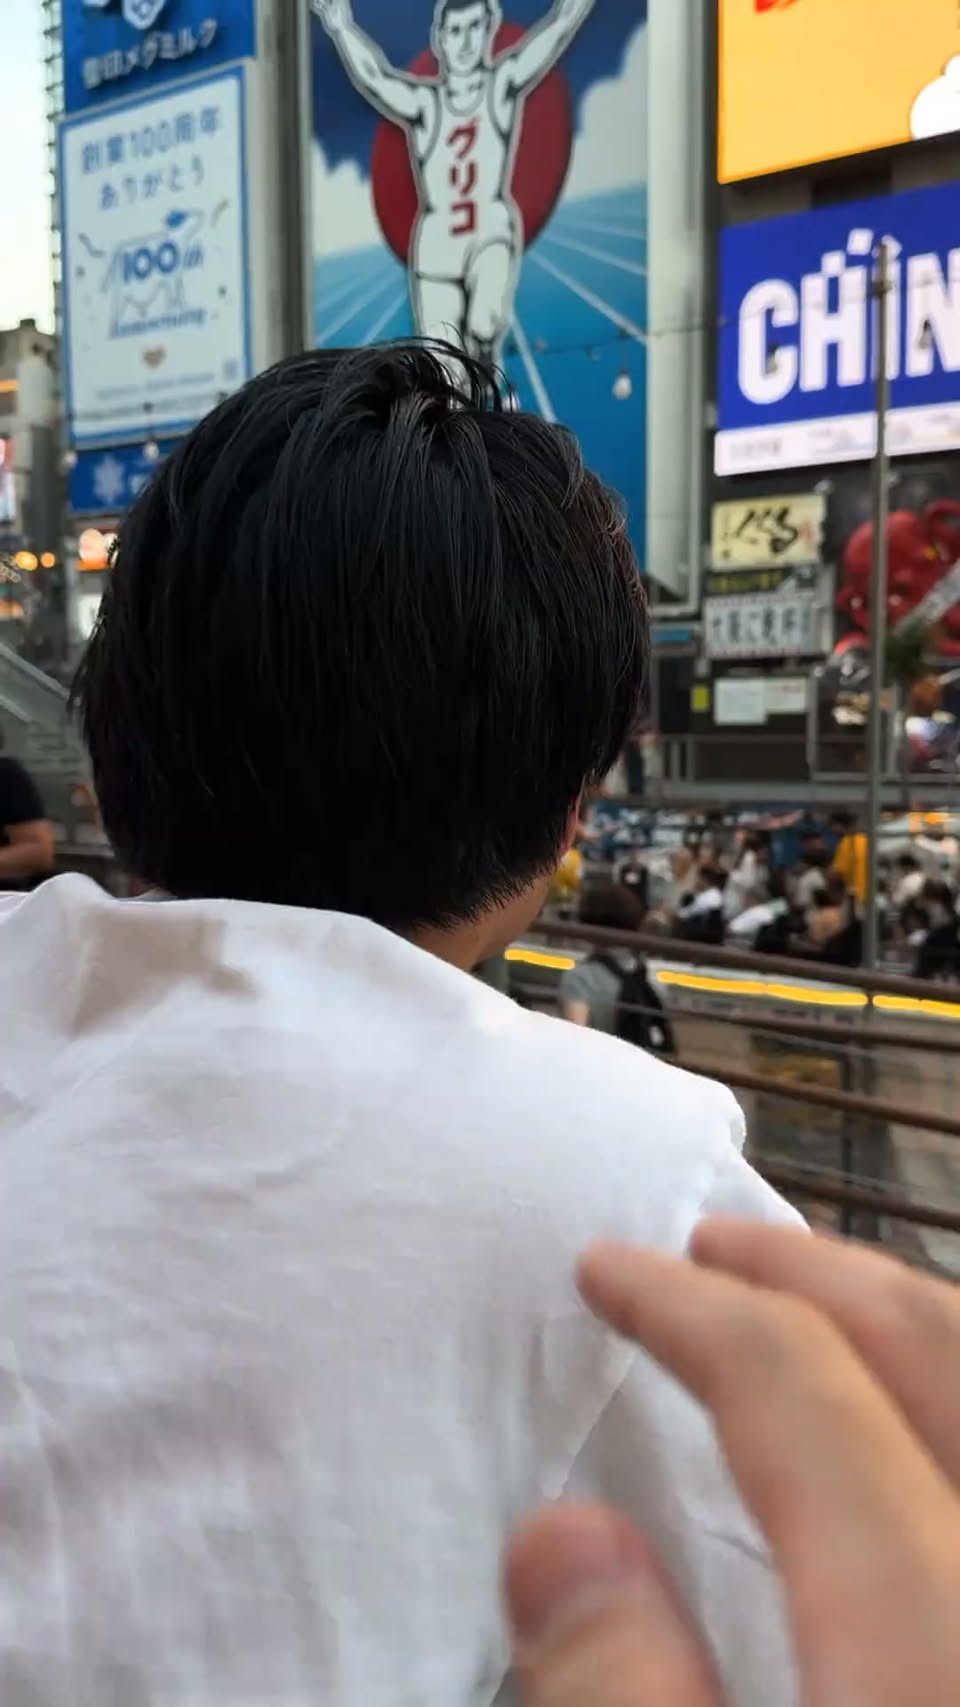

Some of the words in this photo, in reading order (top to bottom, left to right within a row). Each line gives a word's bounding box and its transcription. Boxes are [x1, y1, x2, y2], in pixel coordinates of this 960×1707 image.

[99, 155, 204, 210] ありがとう
[446, 117, 481, 237] グリコ
